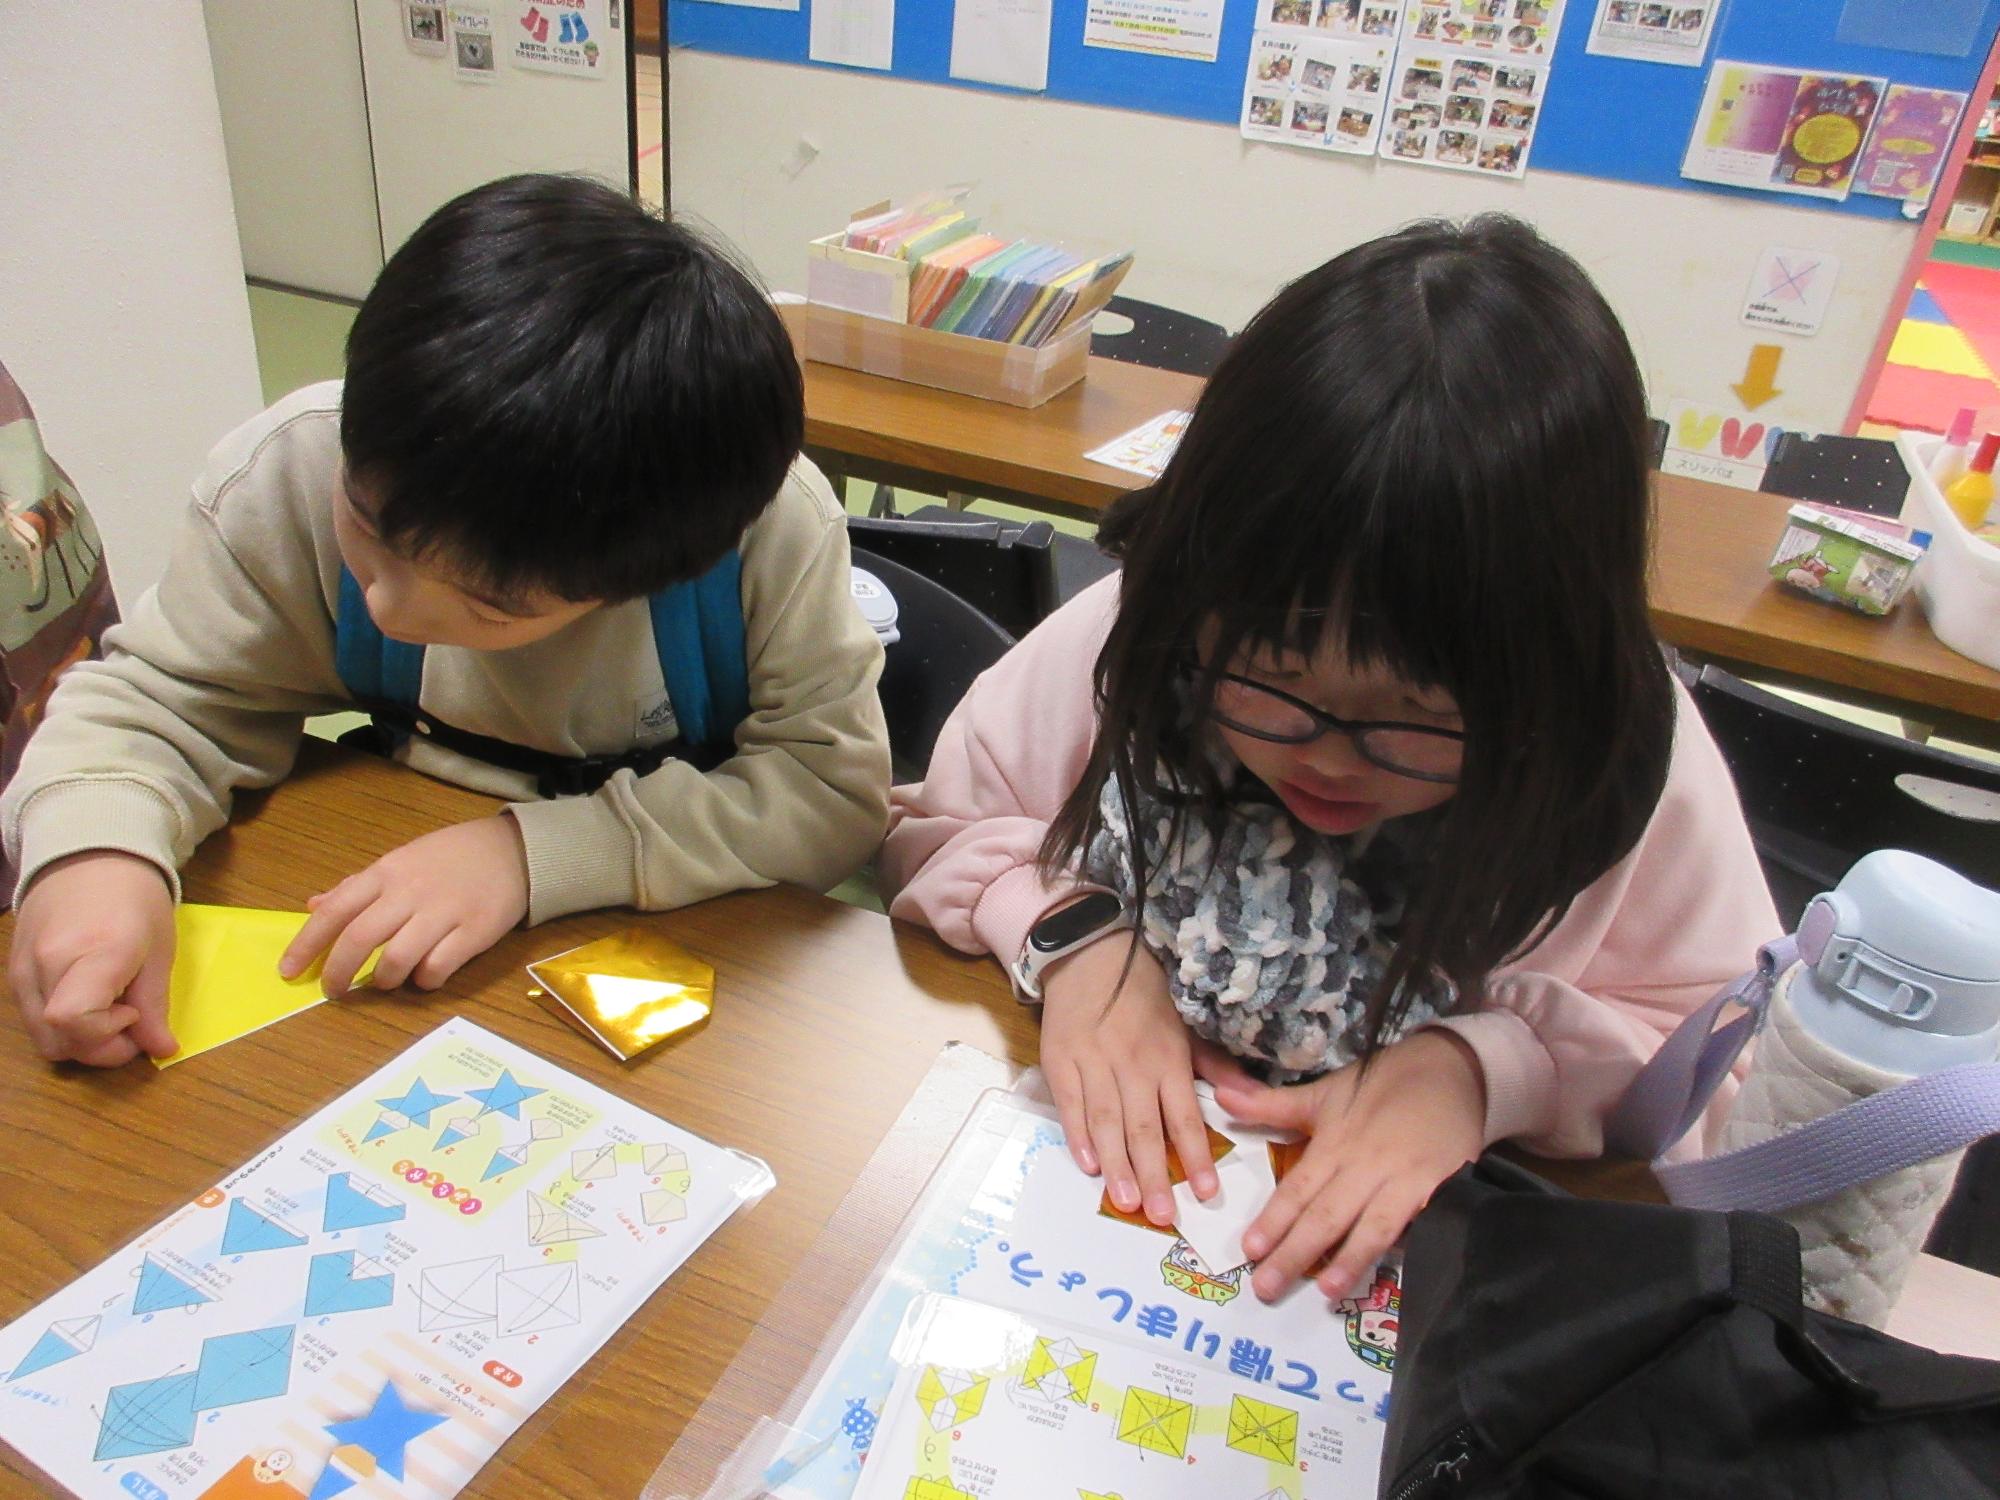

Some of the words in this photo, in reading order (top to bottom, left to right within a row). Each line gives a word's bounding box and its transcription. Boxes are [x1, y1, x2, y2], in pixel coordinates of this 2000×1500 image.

[651, 1176, 661, 1184] 5
[394, 1160, 481, 1212] くみたてかた
[655, 1225, 666, 1235] 6
[541, 1247, 553, 1256] 3
[140, 1313, 154, 1323] 6
[317, 1316, 330, 1325] 3
[526, 1334, 538, 1344] 2
[489, 1363, 516, 1383] かお
[1090, 1402, 1101, 1413] 5
[206, 1411, 220, 1423] 2
[951, 1429, 962, 1442] 6
[1186, 1454, 1197, 1466] 4
[1299, 1460, 1309, 1473] 3
